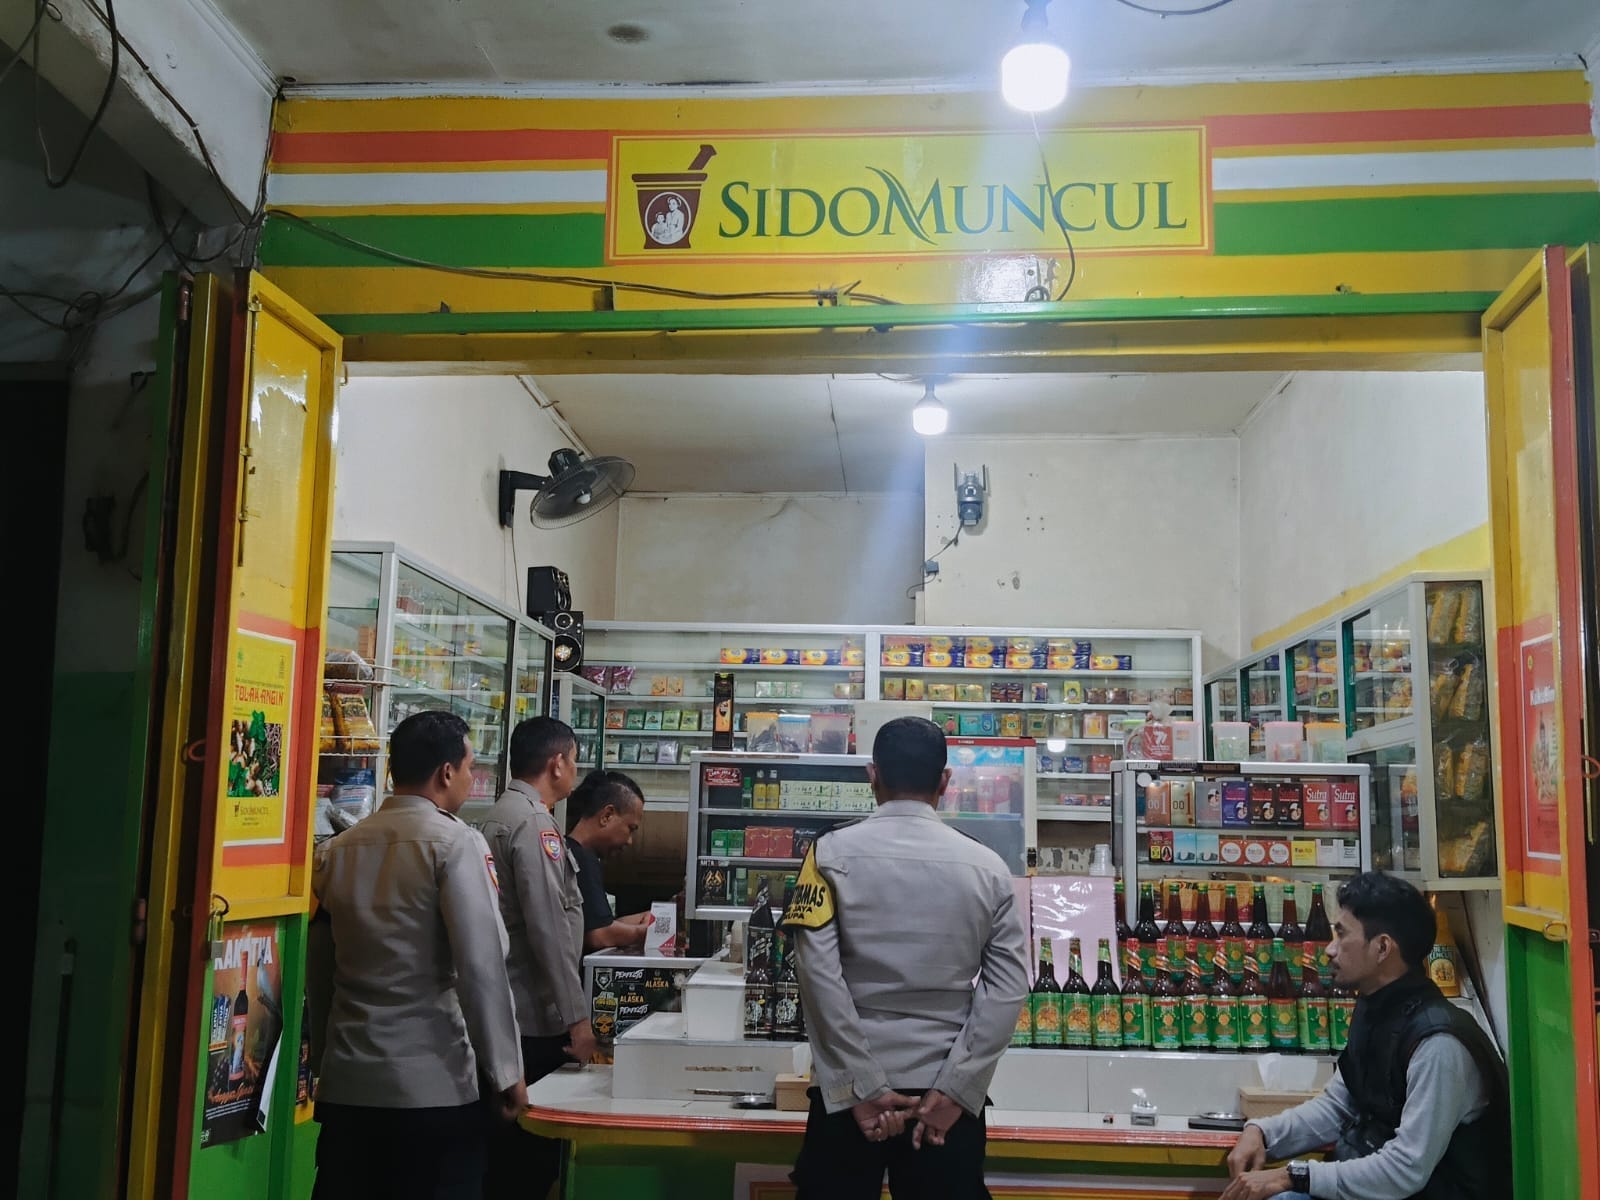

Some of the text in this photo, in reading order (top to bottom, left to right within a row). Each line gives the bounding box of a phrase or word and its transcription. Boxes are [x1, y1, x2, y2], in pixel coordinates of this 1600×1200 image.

[260, 688, 284, 706] ANGIN
[1306, 788, 1328, 802] Sutra
[1334, 789, 1356, 802] Sutra
[645, 980, 669, 988] ALASKA
[620, 995, 644, 1003] ALASKA
